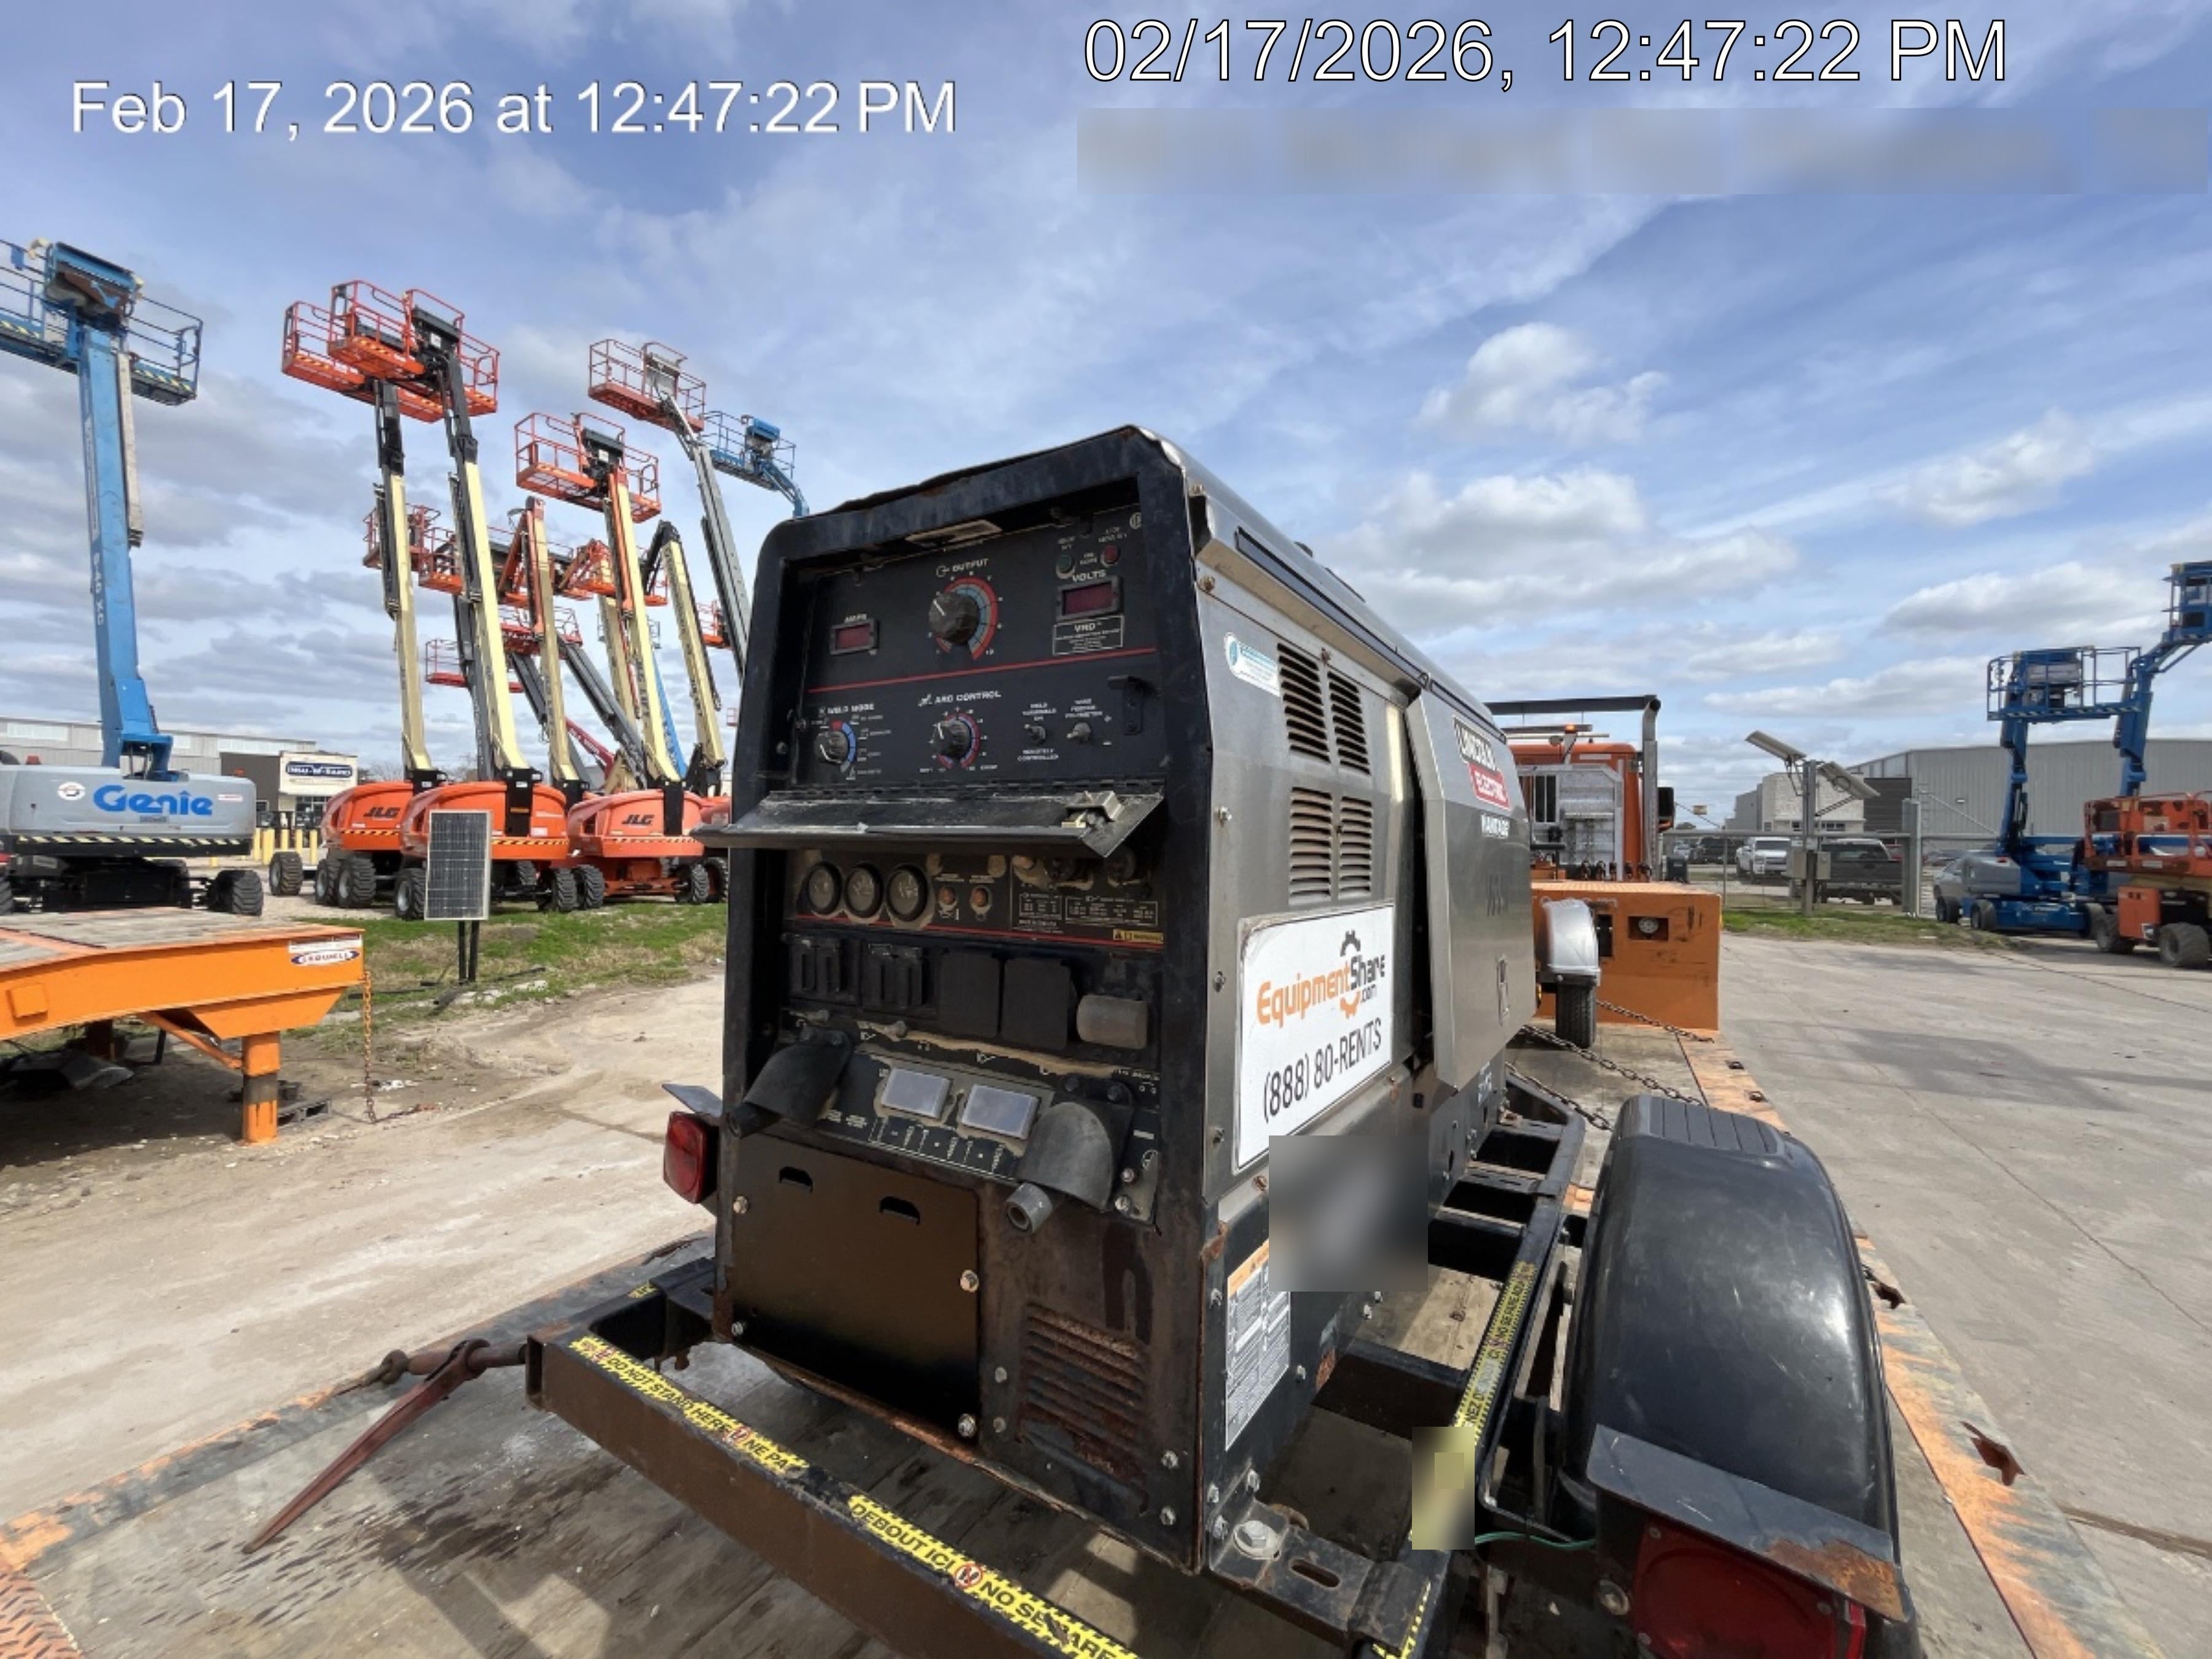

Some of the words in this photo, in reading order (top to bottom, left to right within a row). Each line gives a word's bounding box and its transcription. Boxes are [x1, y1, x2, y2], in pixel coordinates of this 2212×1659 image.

[1072, 570, 1106, 582] VOLTS
[93, 785, 213, 815] Genie
[363, 807, 401, 817] JLG
[622, 814, 655, 825] JLG
[1257, 954, 1386, 1029] EquipmentShare
[1264, 1053, 1309, 1124] (888)
[1314, 1018, 1382, 1089] 80-RENTS
[608, 1358, 627, 1371] DO
[626, 1365, 653, 1385] NOT
[649, 1381, 694, 1410] STAND
[691, 1406, 734, 1433] HERE
[745, 1438, 768, 1456] NE
[851, 1503, 924, 1551] DEBOUT
[925, 1547, 954, 1572] ICI
[980, 1581, 1015, 1607] NO
